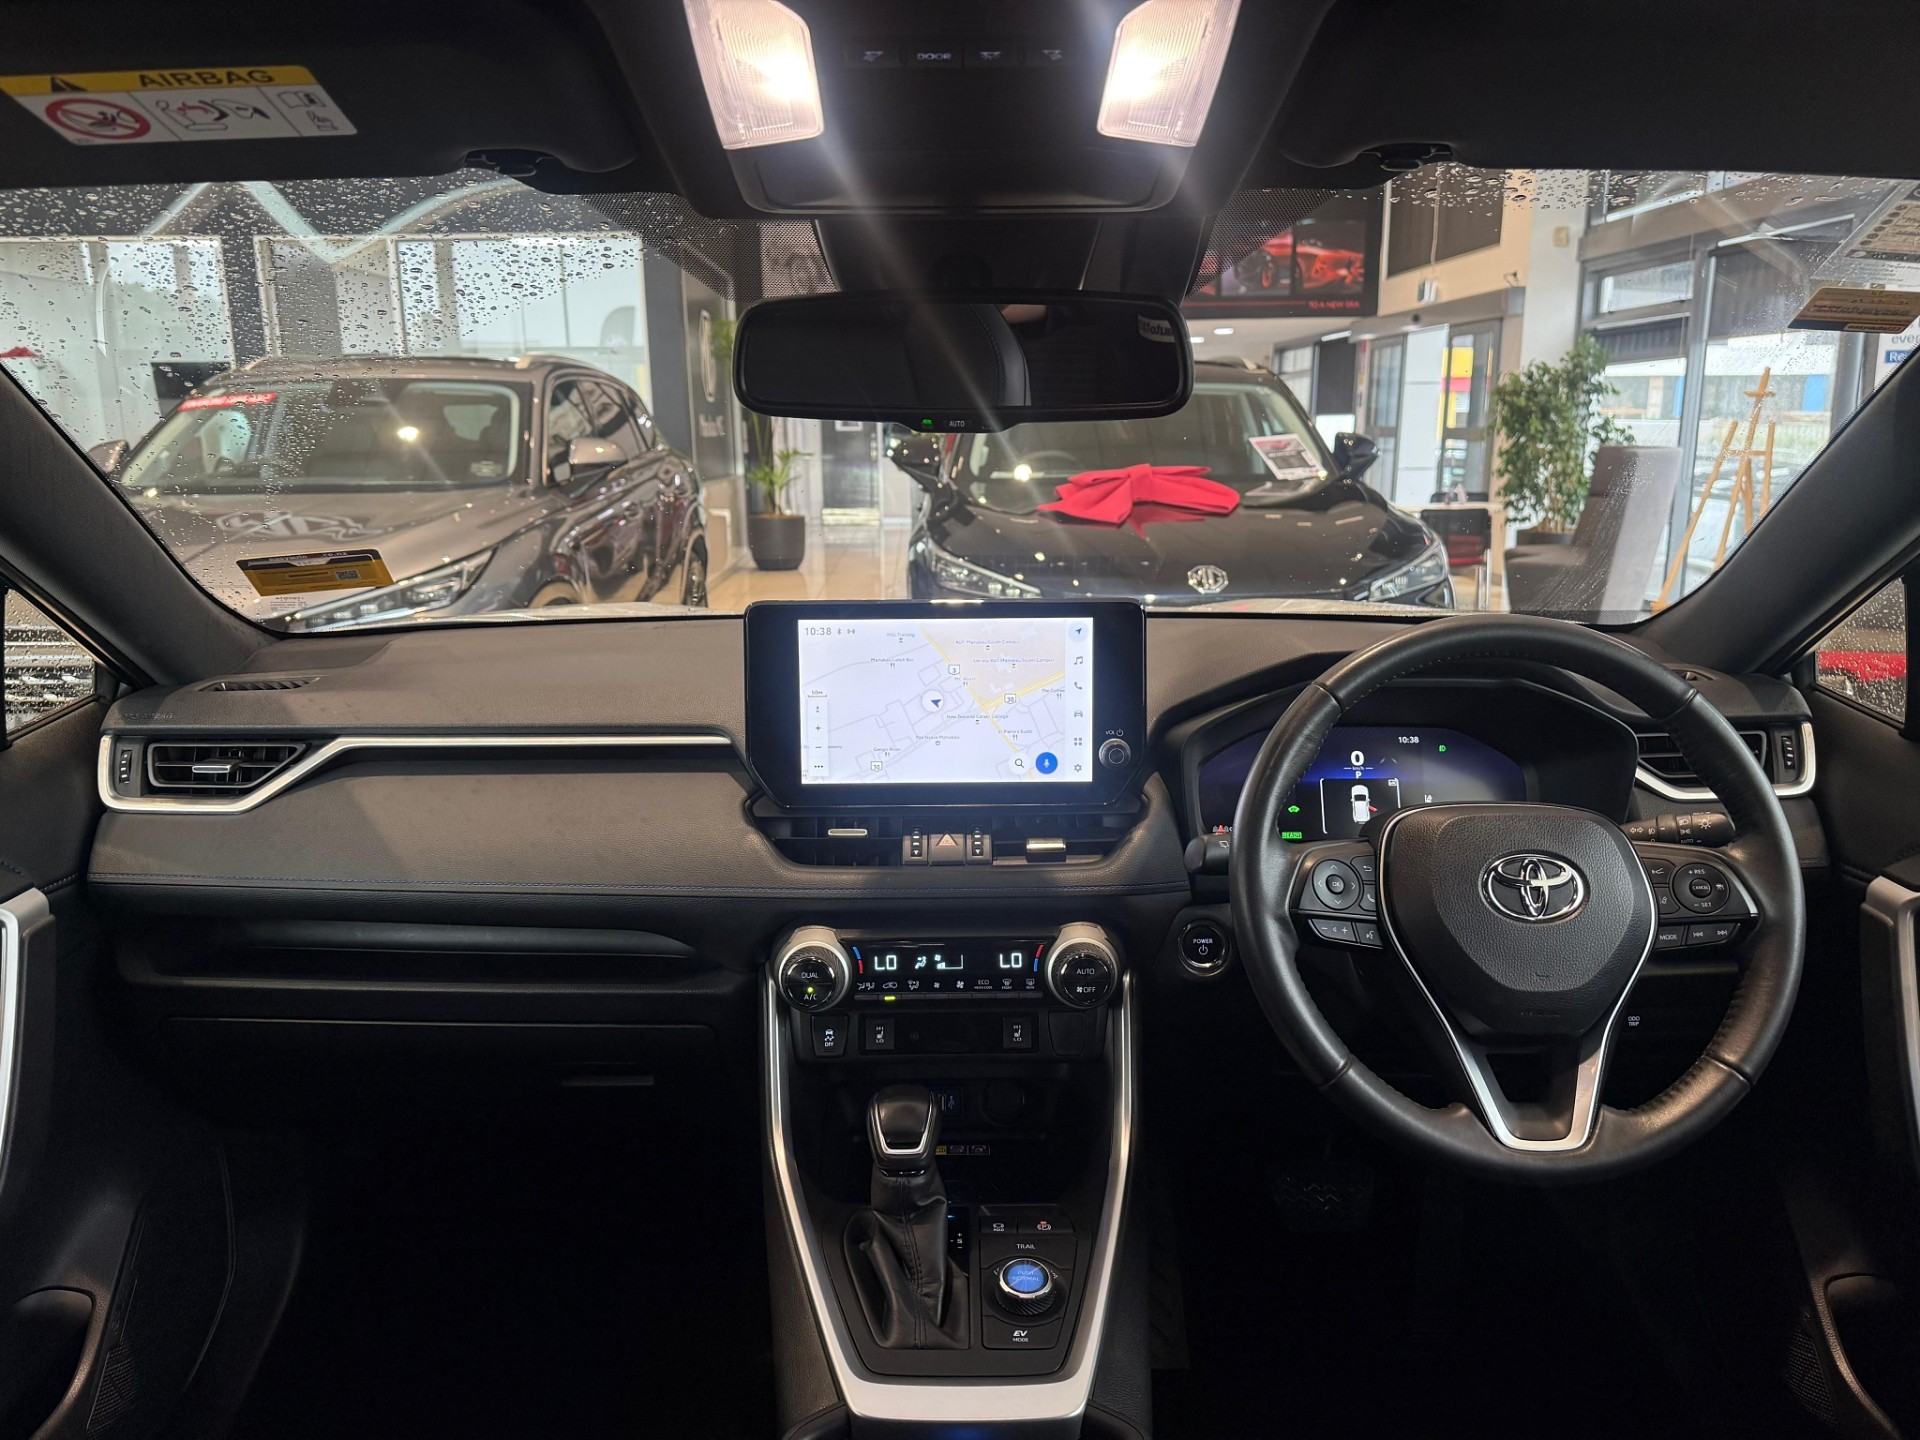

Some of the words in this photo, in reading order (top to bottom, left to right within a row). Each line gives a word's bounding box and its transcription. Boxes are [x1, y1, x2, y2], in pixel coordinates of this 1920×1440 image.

[917, 52, 951, 60] DOOR
[138, 69, 275, 88] AIRBAG
[804, 627, 832, 636] 10:38
[1398, 736, 1420, 744] 10:38
[1350, 750, 1365, 766] 0
[1355, 771, 1362, 779] P
[801, 971, 819, 979] DUAL
